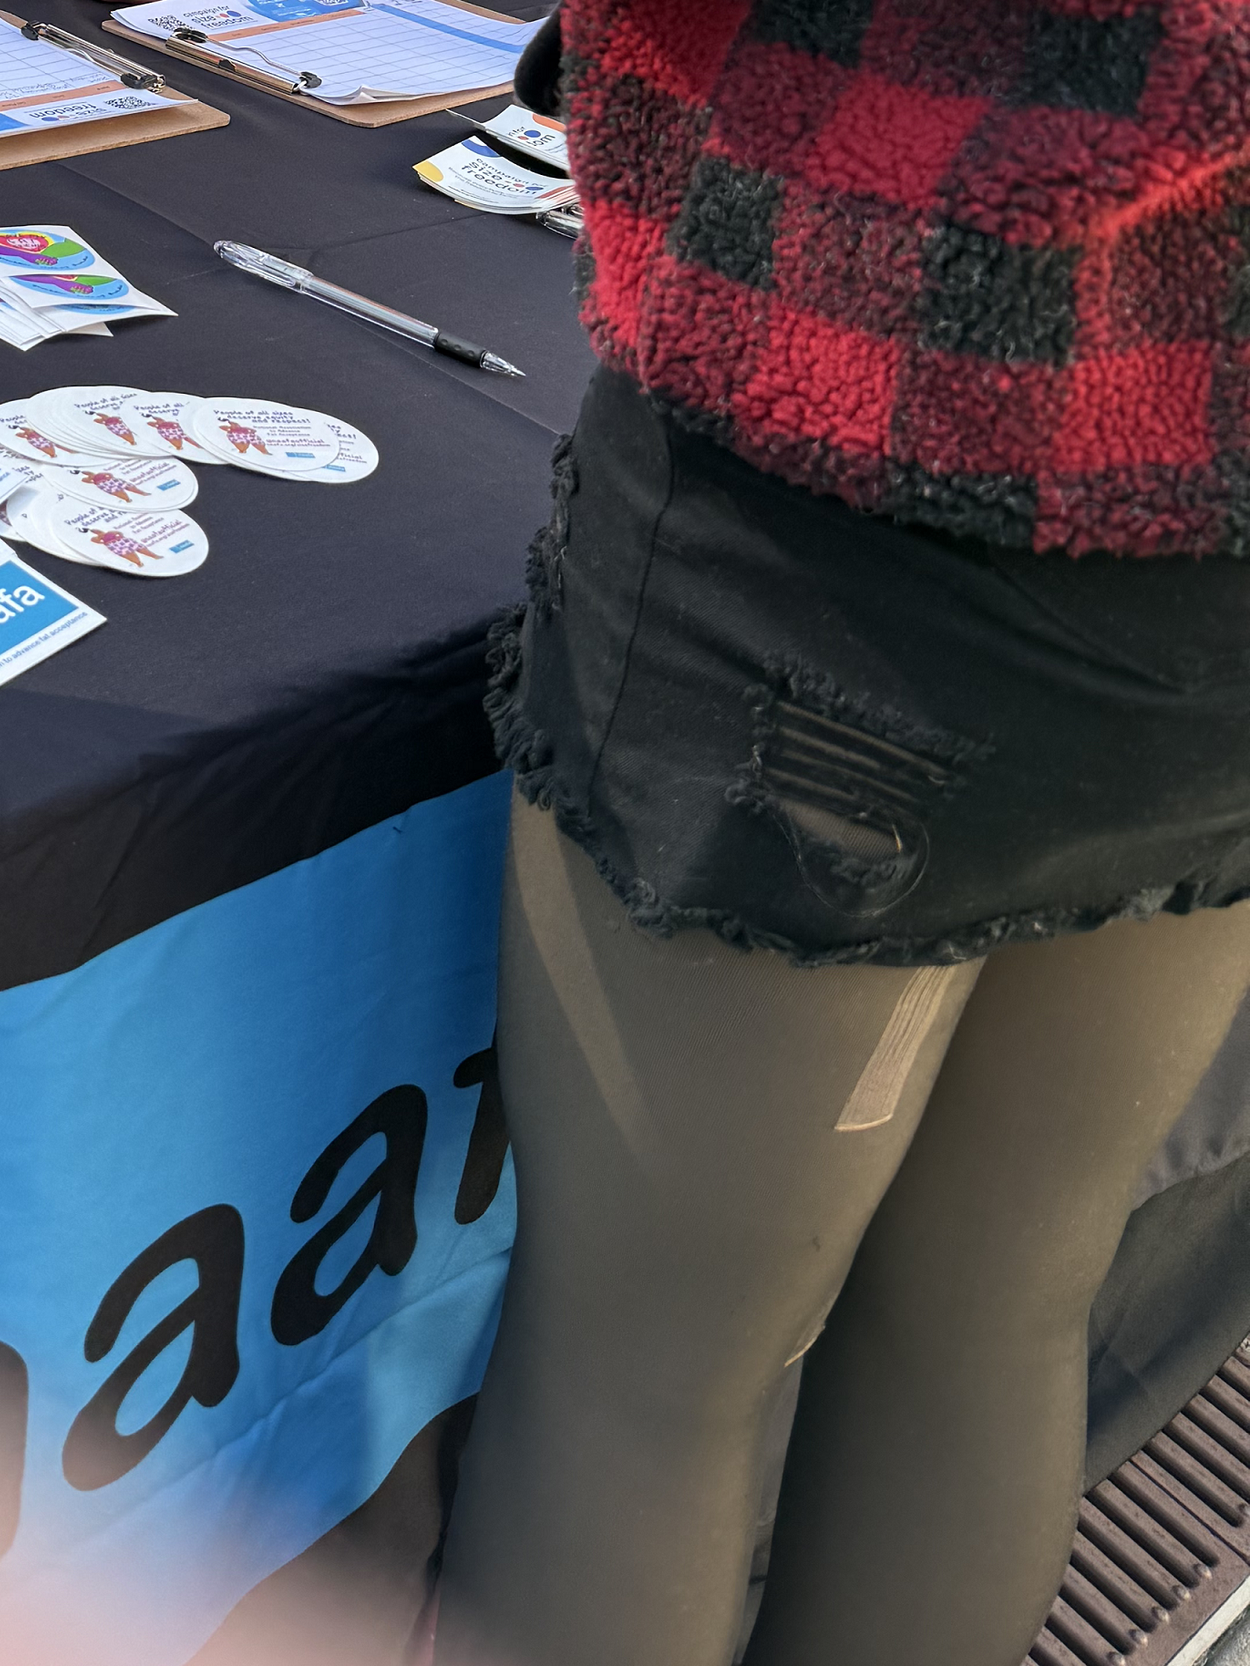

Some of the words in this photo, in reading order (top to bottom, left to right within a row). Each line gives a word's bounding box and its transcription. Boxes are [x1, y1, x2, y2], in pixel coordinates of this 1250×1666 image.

[3, 655, 13, 665] to
[12, 639, 41, 660] advance
[39, 632, 51, 643] fat
[50, 610, 88, 637] acceptance
